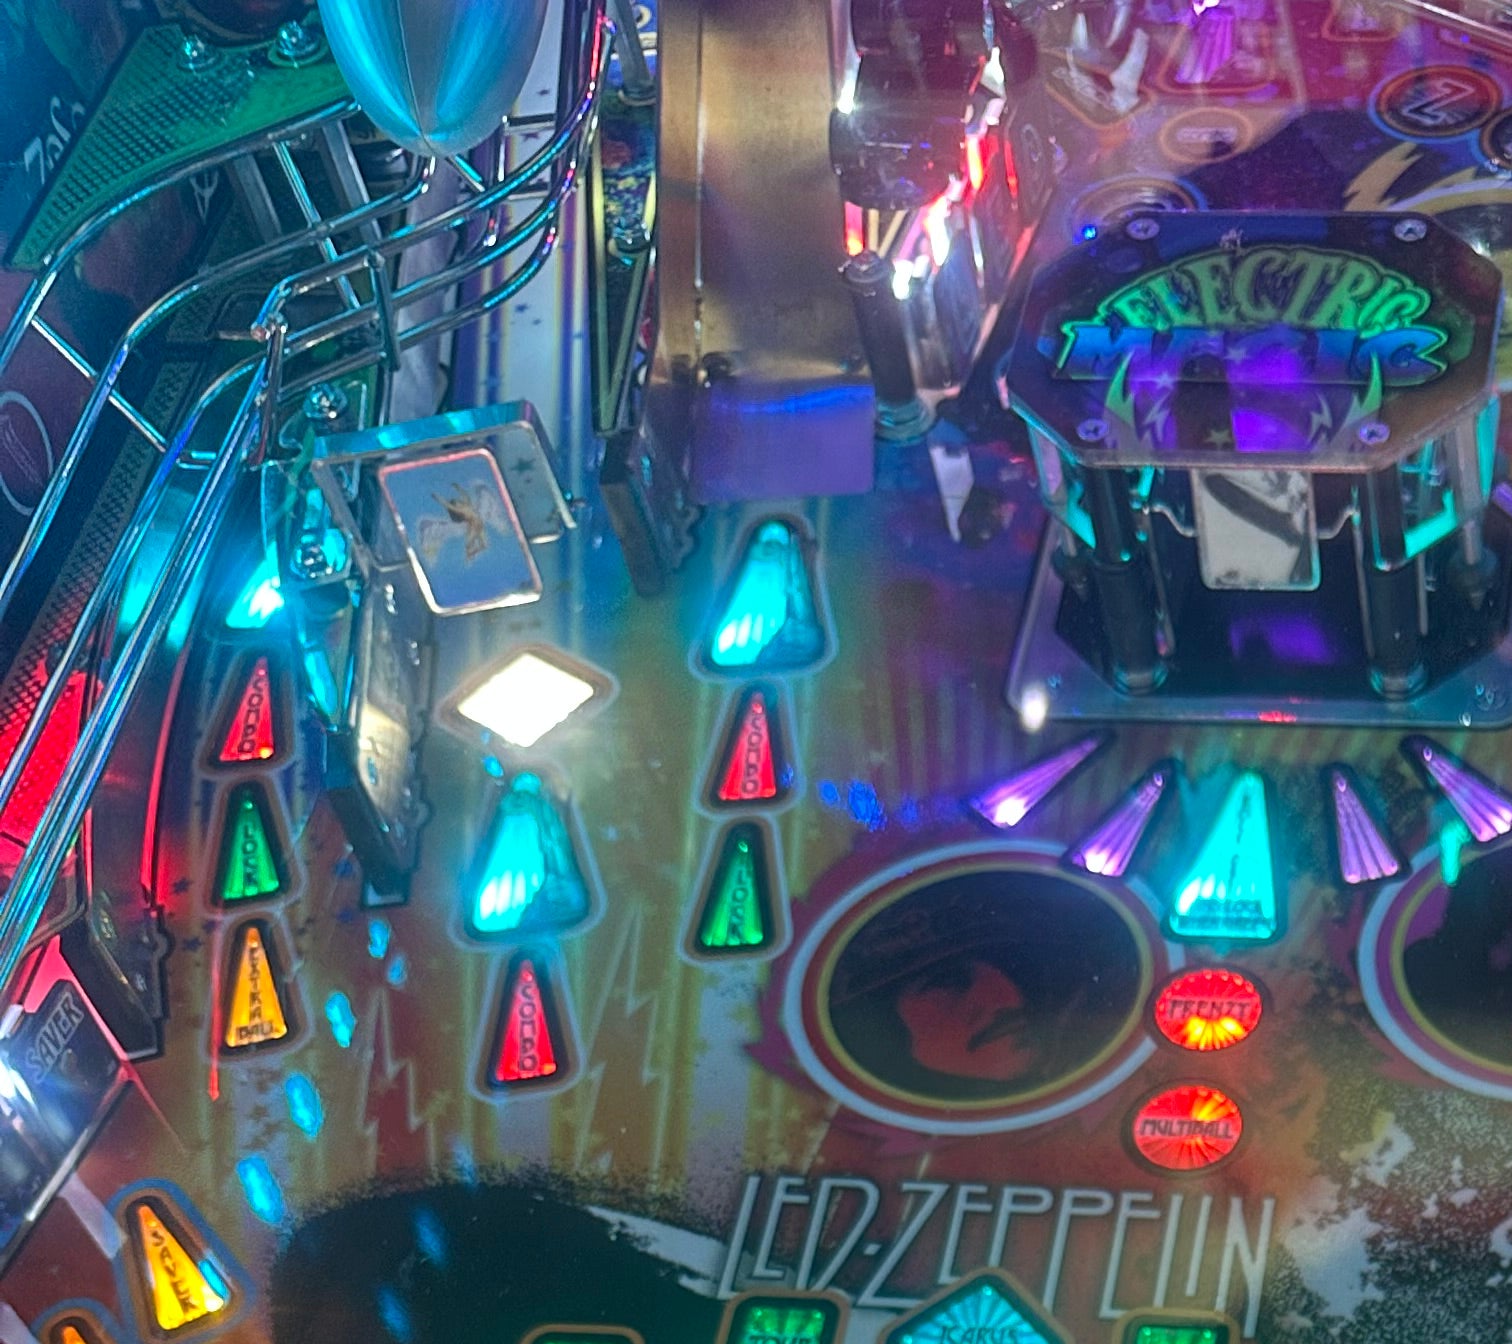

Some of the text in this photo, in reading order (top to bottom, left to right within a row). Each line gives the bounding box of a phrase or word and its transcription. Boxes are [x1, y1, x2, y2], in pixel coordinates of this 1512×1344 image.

[1098, 246, 1433, 338] ELECTRIC
[742, 716, 763, 795] COMBO
[25, 990, 85, 1083] SAVER
[518, 983, 538, 1072] COMBO
[1141, 1118, 1234, 1140] MULTIBALL
